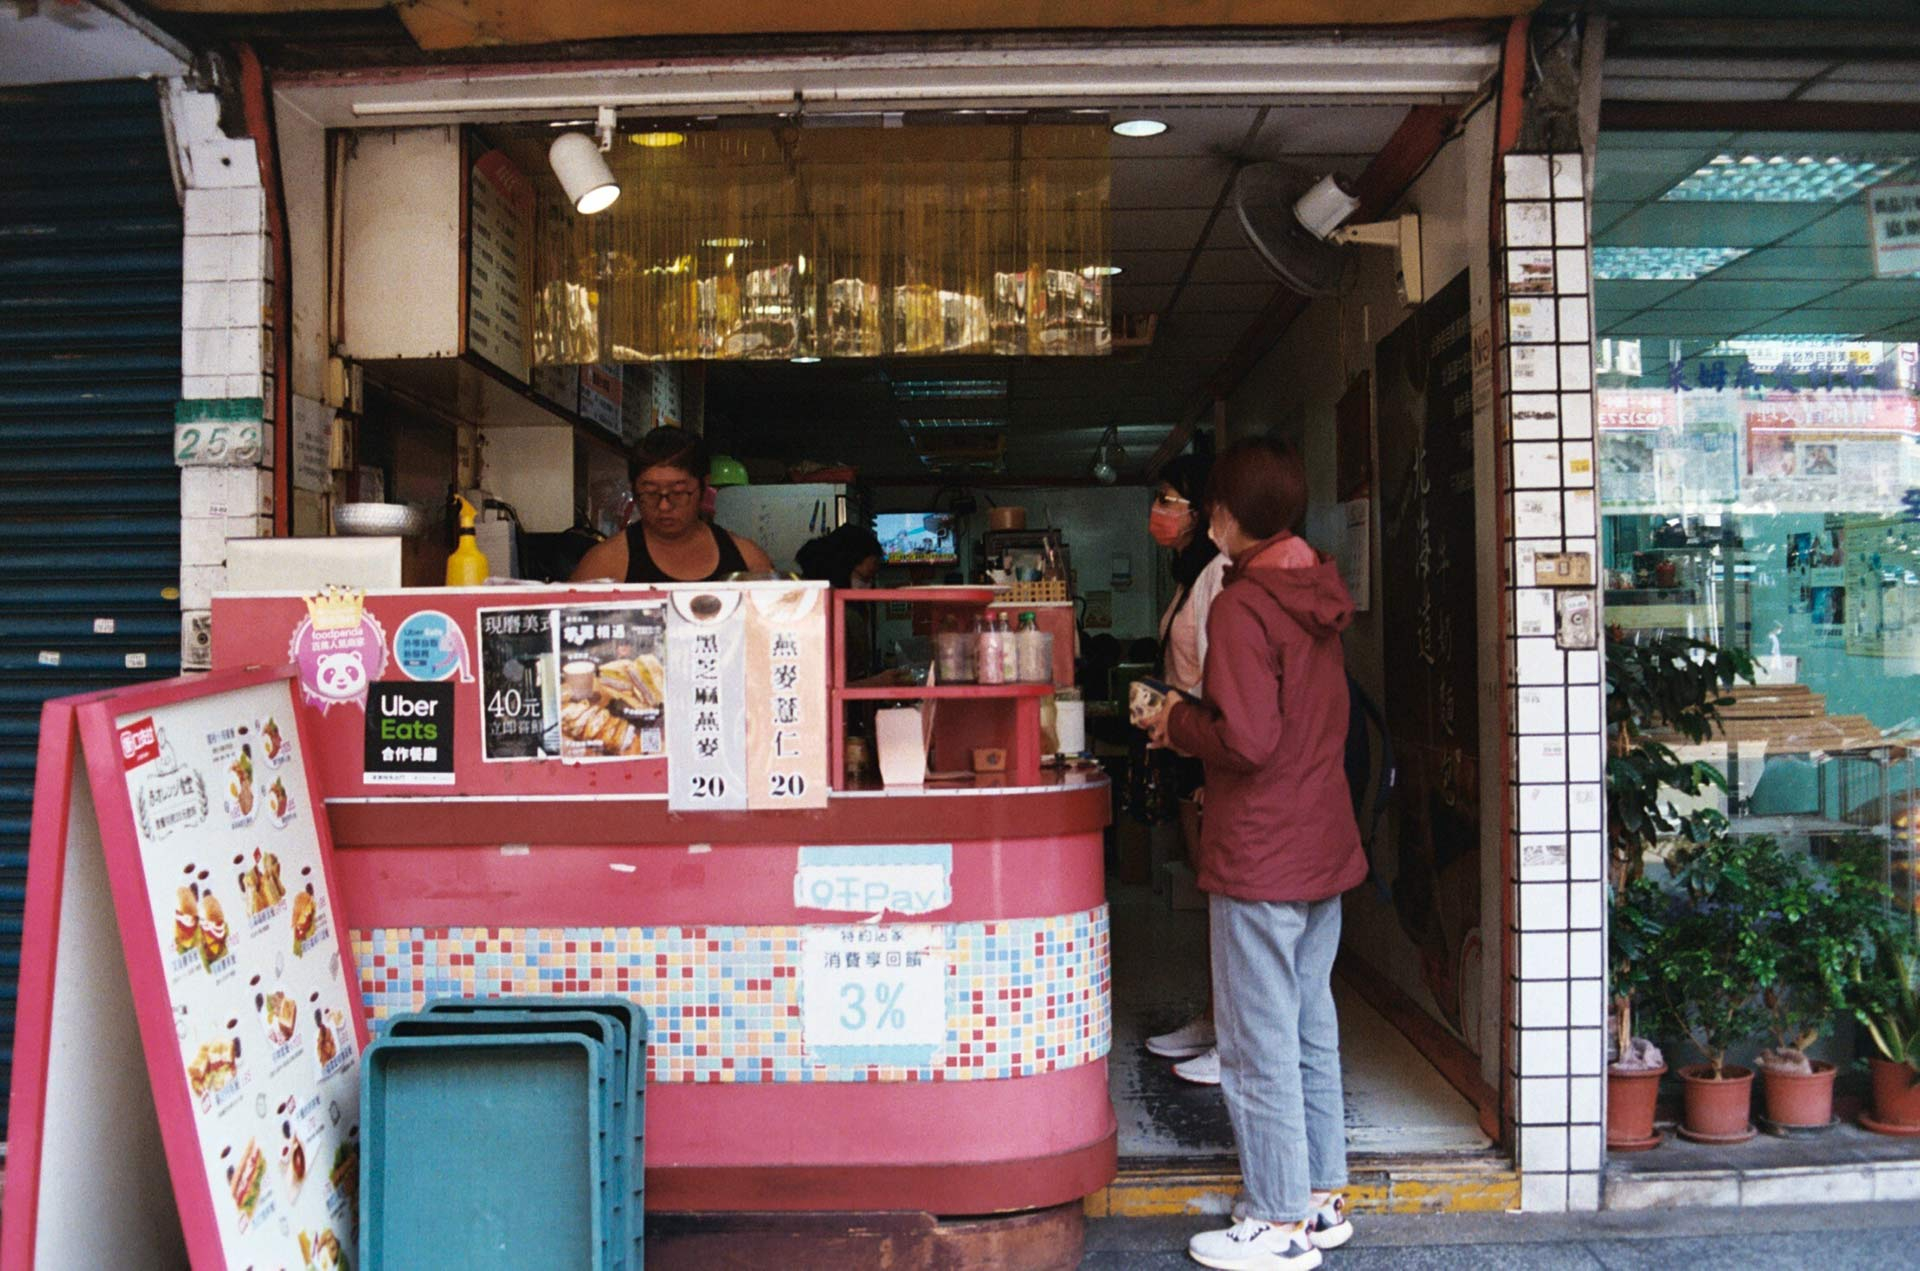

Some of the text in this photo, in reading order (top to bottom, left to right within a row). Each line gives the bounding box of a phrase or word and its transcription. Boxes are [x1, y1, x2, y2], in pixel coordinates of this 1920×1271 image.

[178, 427, 257, 460] 253
[381, 694, 439, 717] Uber
[694, 633, 720, 757] 黑芝麻燕麥
[772, 632, 799, 757] 燕麥薏仁
[381, 718, 438, 740] Eats
[381, 745, 438, 762] 合作餐廳
[691, 775, 725, 798] 20
[770, 774, 805, 797] 20
[824, 951, 922, 968] 消費享回饋
[839, 981, 905, 1031] 3%
